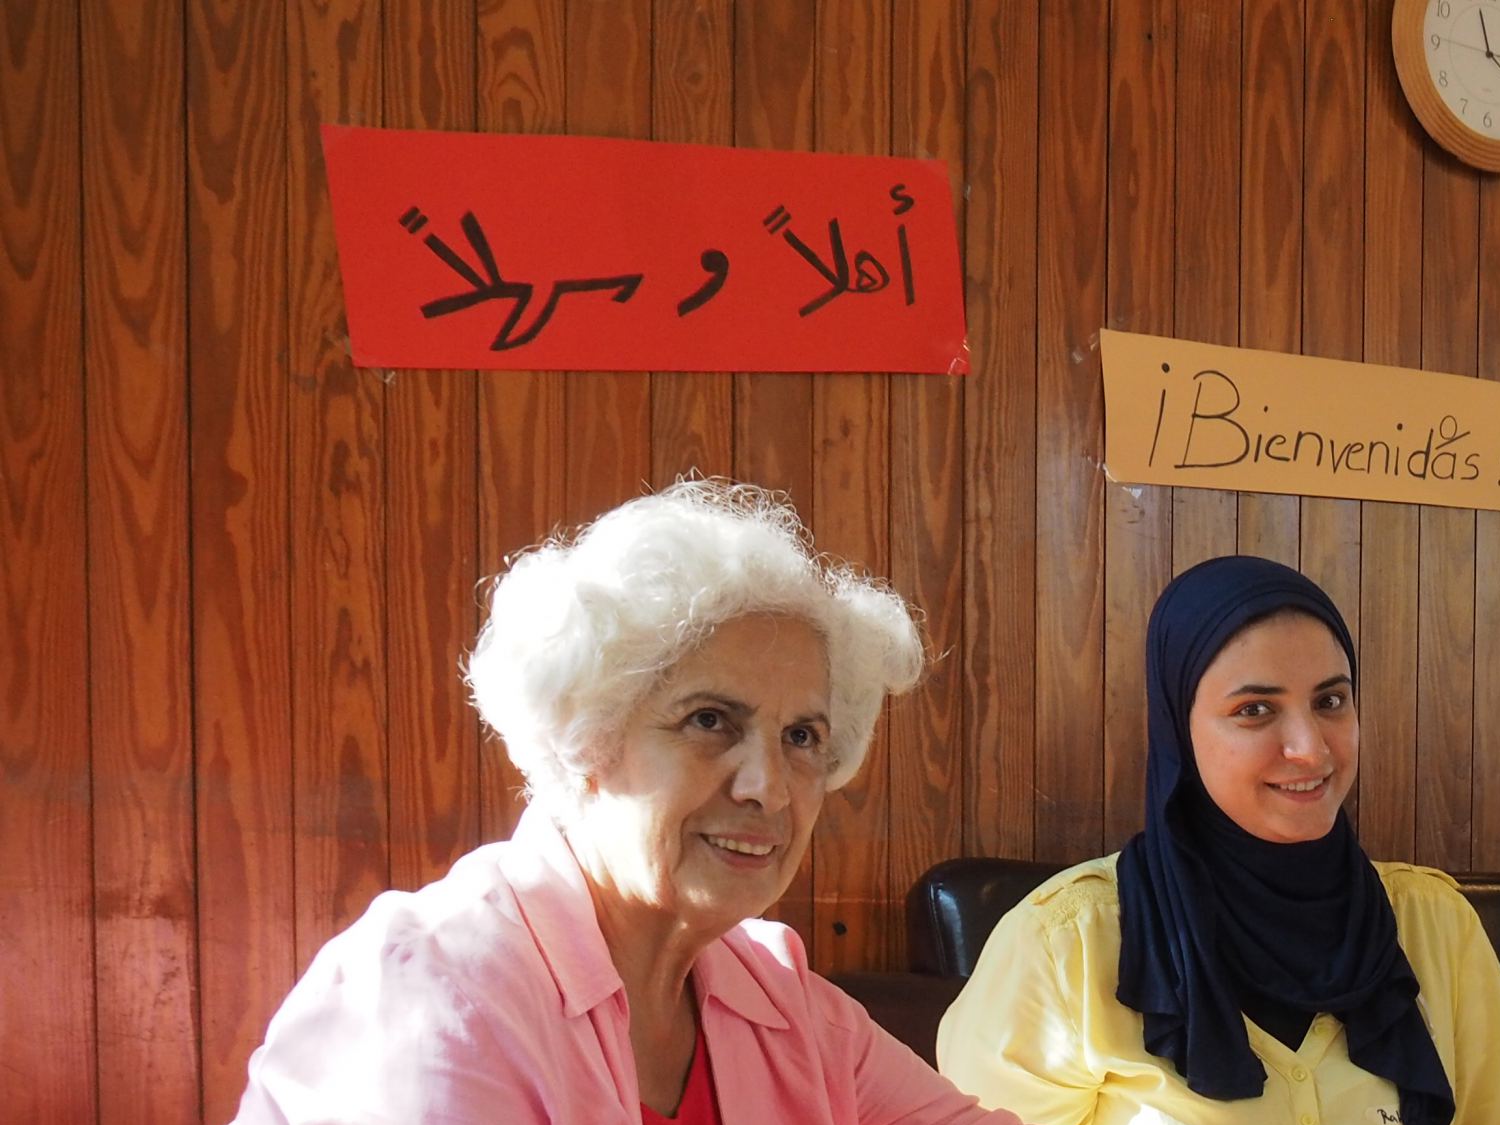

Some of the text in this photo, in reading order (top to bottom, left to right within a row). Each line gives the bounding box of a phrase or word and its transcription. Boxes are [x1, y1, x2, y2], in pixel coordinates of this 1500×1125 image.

[1430, 33, 1441, 50] 9
[1438, 71, 1448, 88] 8
[1460, 98, 1468, 114] 7
[1483, 112, 1492, 128] 6
